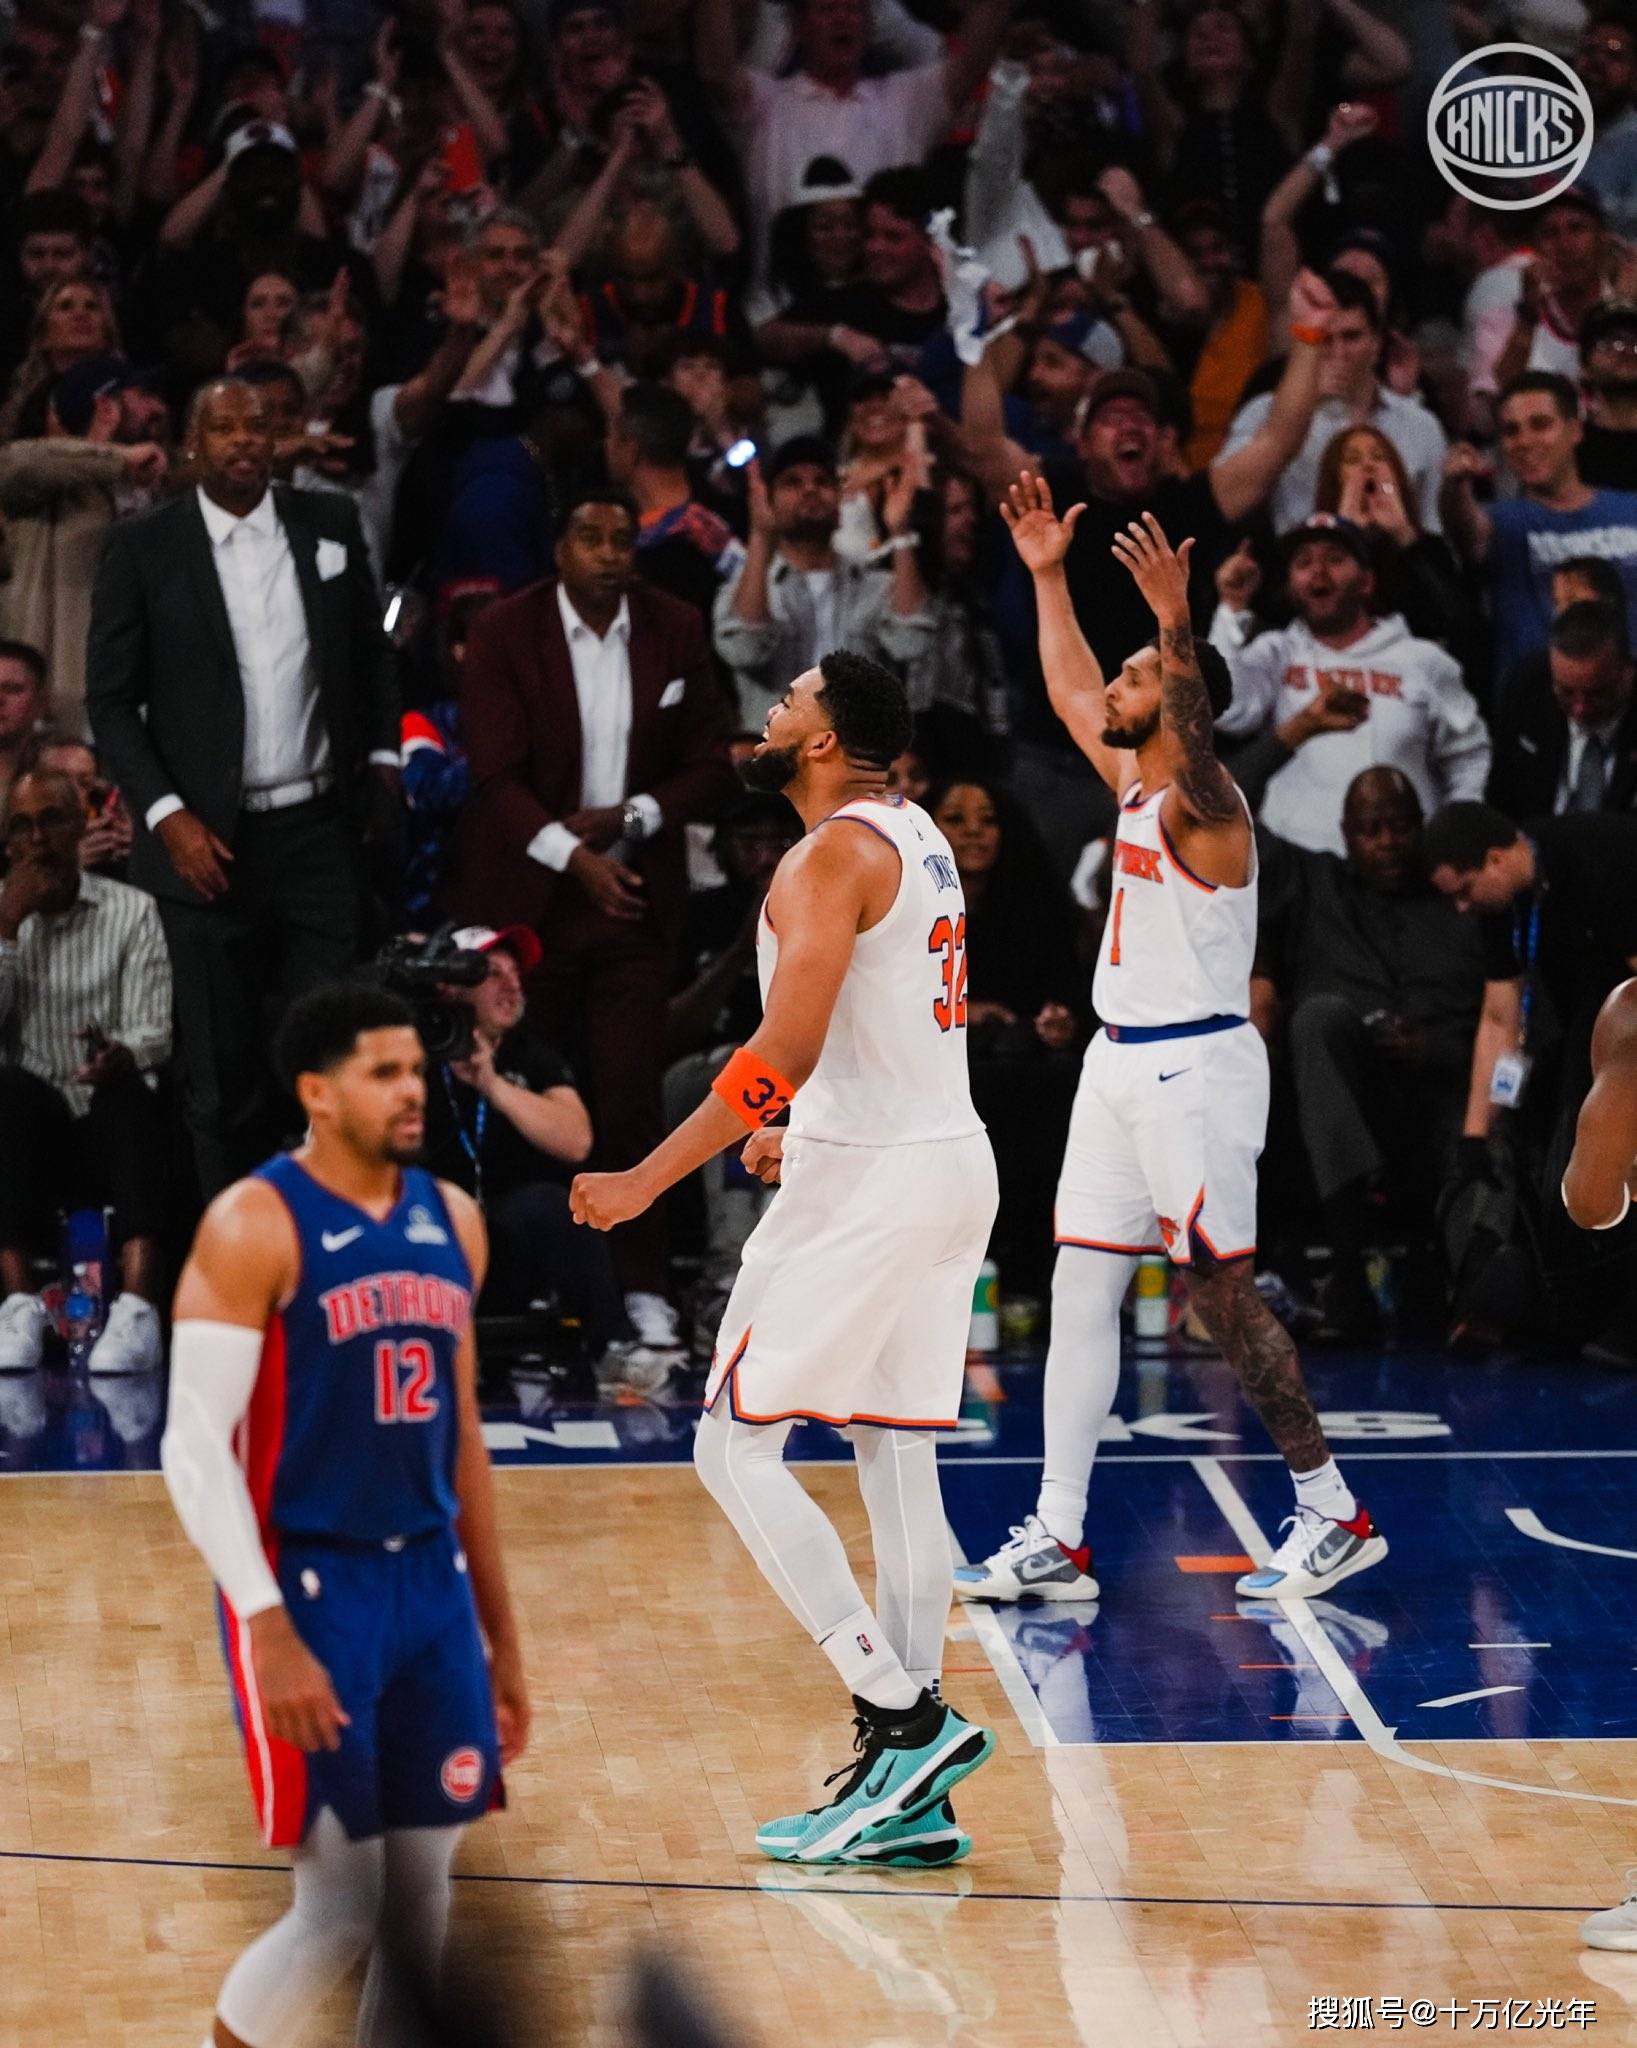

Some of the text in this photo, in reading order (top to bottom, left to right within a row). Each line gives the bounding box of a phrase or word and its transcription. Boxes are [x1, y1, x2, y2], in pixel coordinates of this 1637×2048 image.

[923, 854, 958, 894] TOWNS
[1110, 887, 1124, 966] 1
[928, 912, 968, 1033] 32
[374, 1337, 440, 1424] 12
